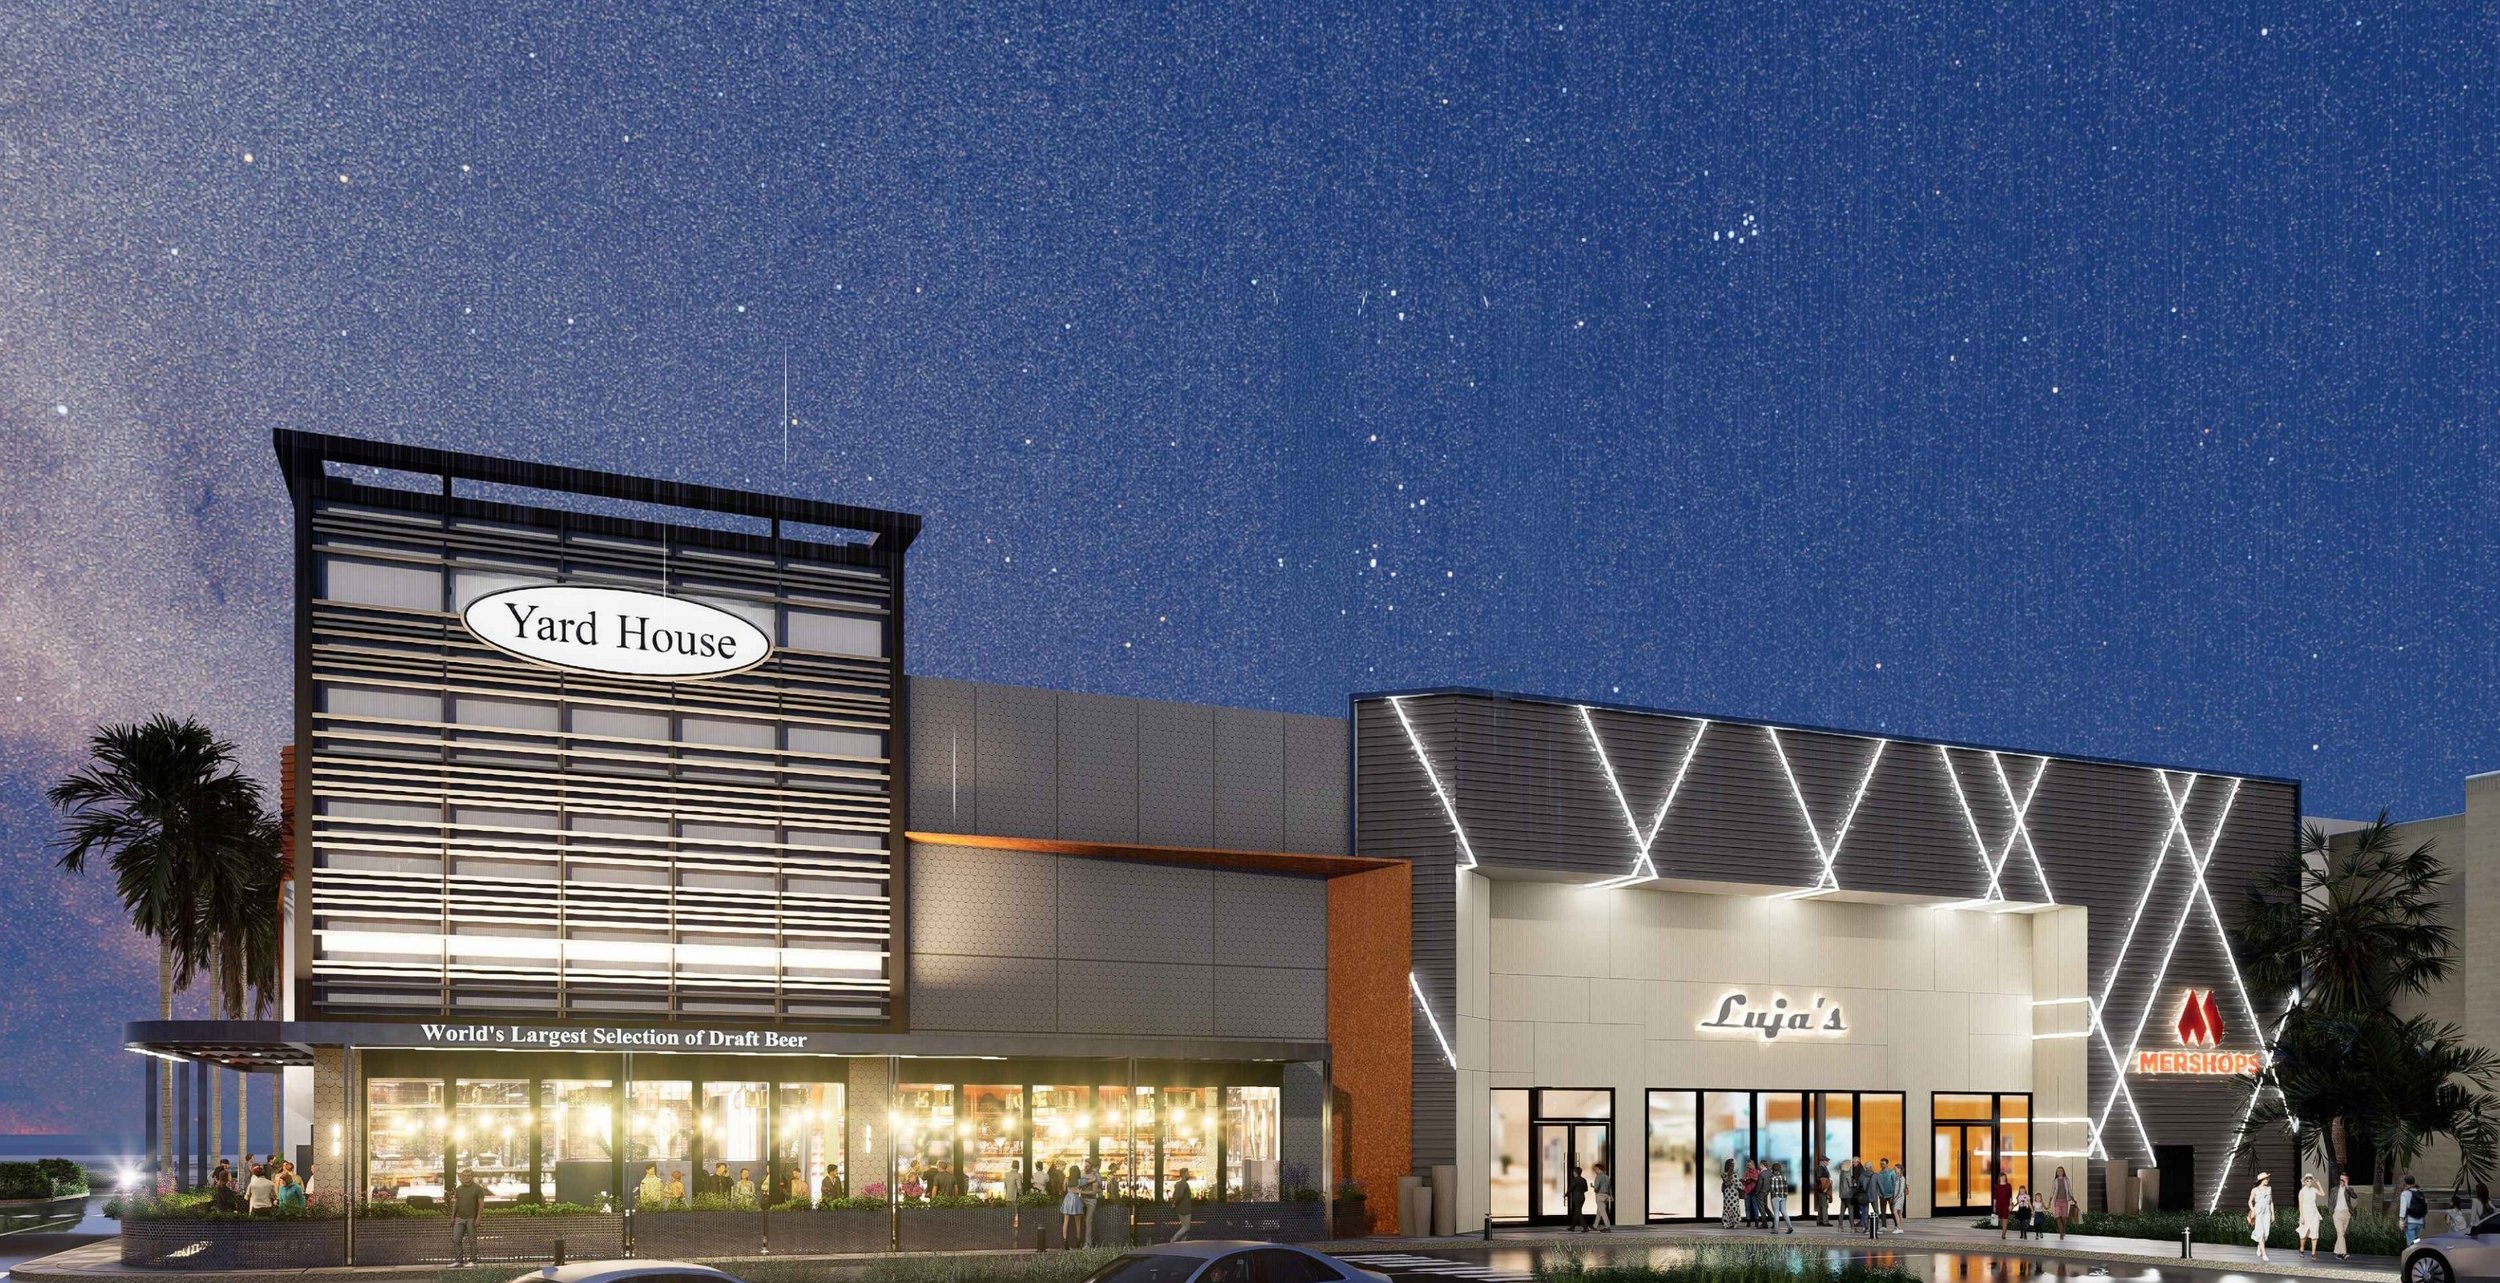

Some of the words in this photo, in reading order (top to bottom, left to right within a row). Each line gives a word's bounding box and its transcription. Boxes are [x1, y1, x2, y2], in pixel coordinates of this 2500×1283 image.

[504, 602, 599, 646] Yard
[616, 614, 737, 659] House
[1701, 994, 1848, 1039] Luja's
[420, 1024, 505, 1042] World's
[511, 1026, 588, 1047] Largest
[593, 1028, 680, 1046] Selection
[684, 1030, 706, 1046] of
[708, 1031, 760, 1047] Draft
[764, 1031, 808, 1048] Beer
[2139, 1051, 2261, 1076] MERSHOPS
